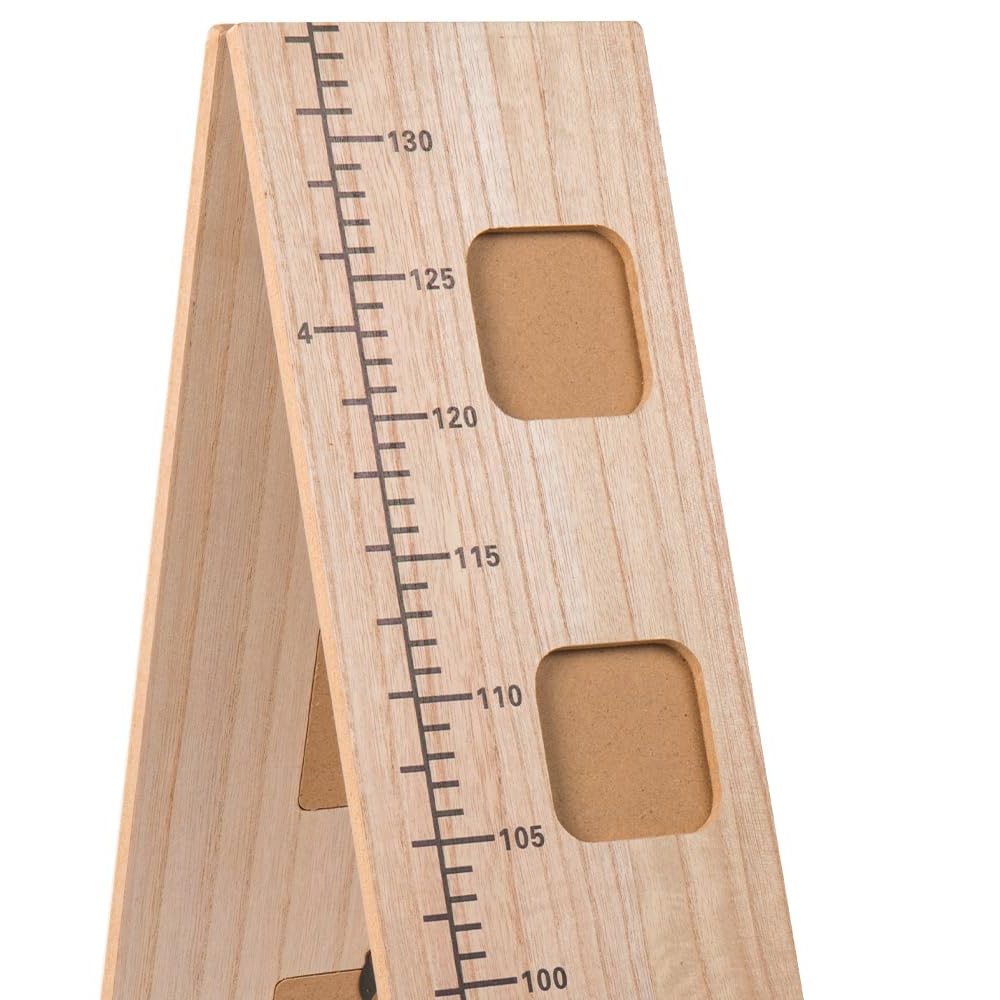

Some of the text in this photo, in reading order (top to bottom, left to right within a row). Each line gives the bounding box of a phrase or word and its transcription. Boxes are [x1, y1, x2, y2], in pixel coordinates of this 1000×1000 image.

[387, 129, 433, 153] 130
[410, 267, 456, 291] 125
[297, 322, 313, 344] 4
[432, 405, 478, 430] 120
[454, 544, 501, 569] 115
[476, 684, 523, 710] 110
[499, 824, 545, 851] 105
[521, 966, 568, 993] 100
